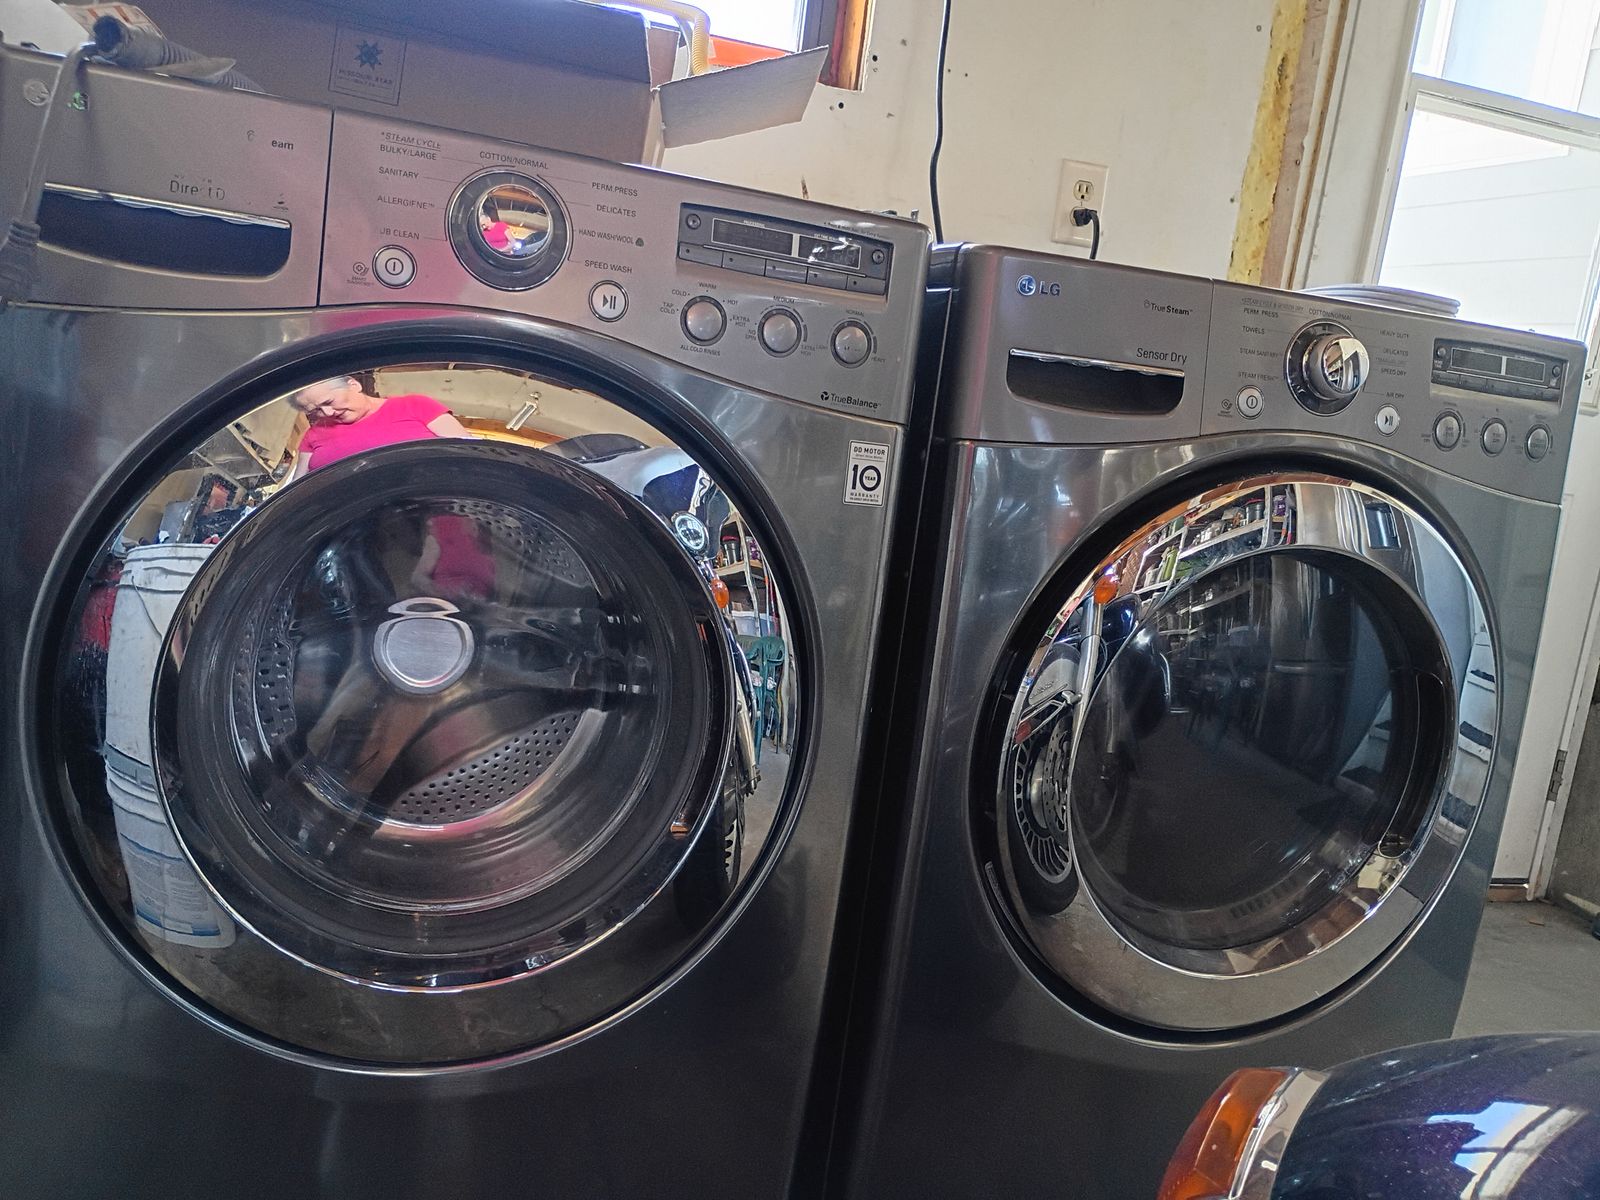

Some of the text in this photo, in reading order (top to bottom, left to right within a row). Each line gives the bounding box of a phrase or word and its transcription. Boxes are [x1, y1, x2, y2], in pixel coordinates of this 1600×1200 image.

[380, 144, 437, 160] BULKY/LARGE
[479, 151, 548, 169] COTTON/NORMAL
[379, 166, 419, 179] SANITARY
[596, 204, 637, 217] DELICATES
[393, 229, 420, 240] CLEAN
[578, 230, 596, 238] HAND
[584, 259, 633, 274] SPEED WASH
[698, 282, 717, 290] WARM
[1039, 280, 1061, 296] LG
[671, 289, 687, 297] COLD
[660, 307, 675, 315] COLD
[1261, 309, 1279, 318] PRESS
[1242, 325, 1265, 335] TOWELS
[690, 345, 703, 353] COLD
[1136, 347, 1188, 365] Sensor Dry
[864, 447, 886, 455] MOTOR
[851, 464, 882, 492] 10
